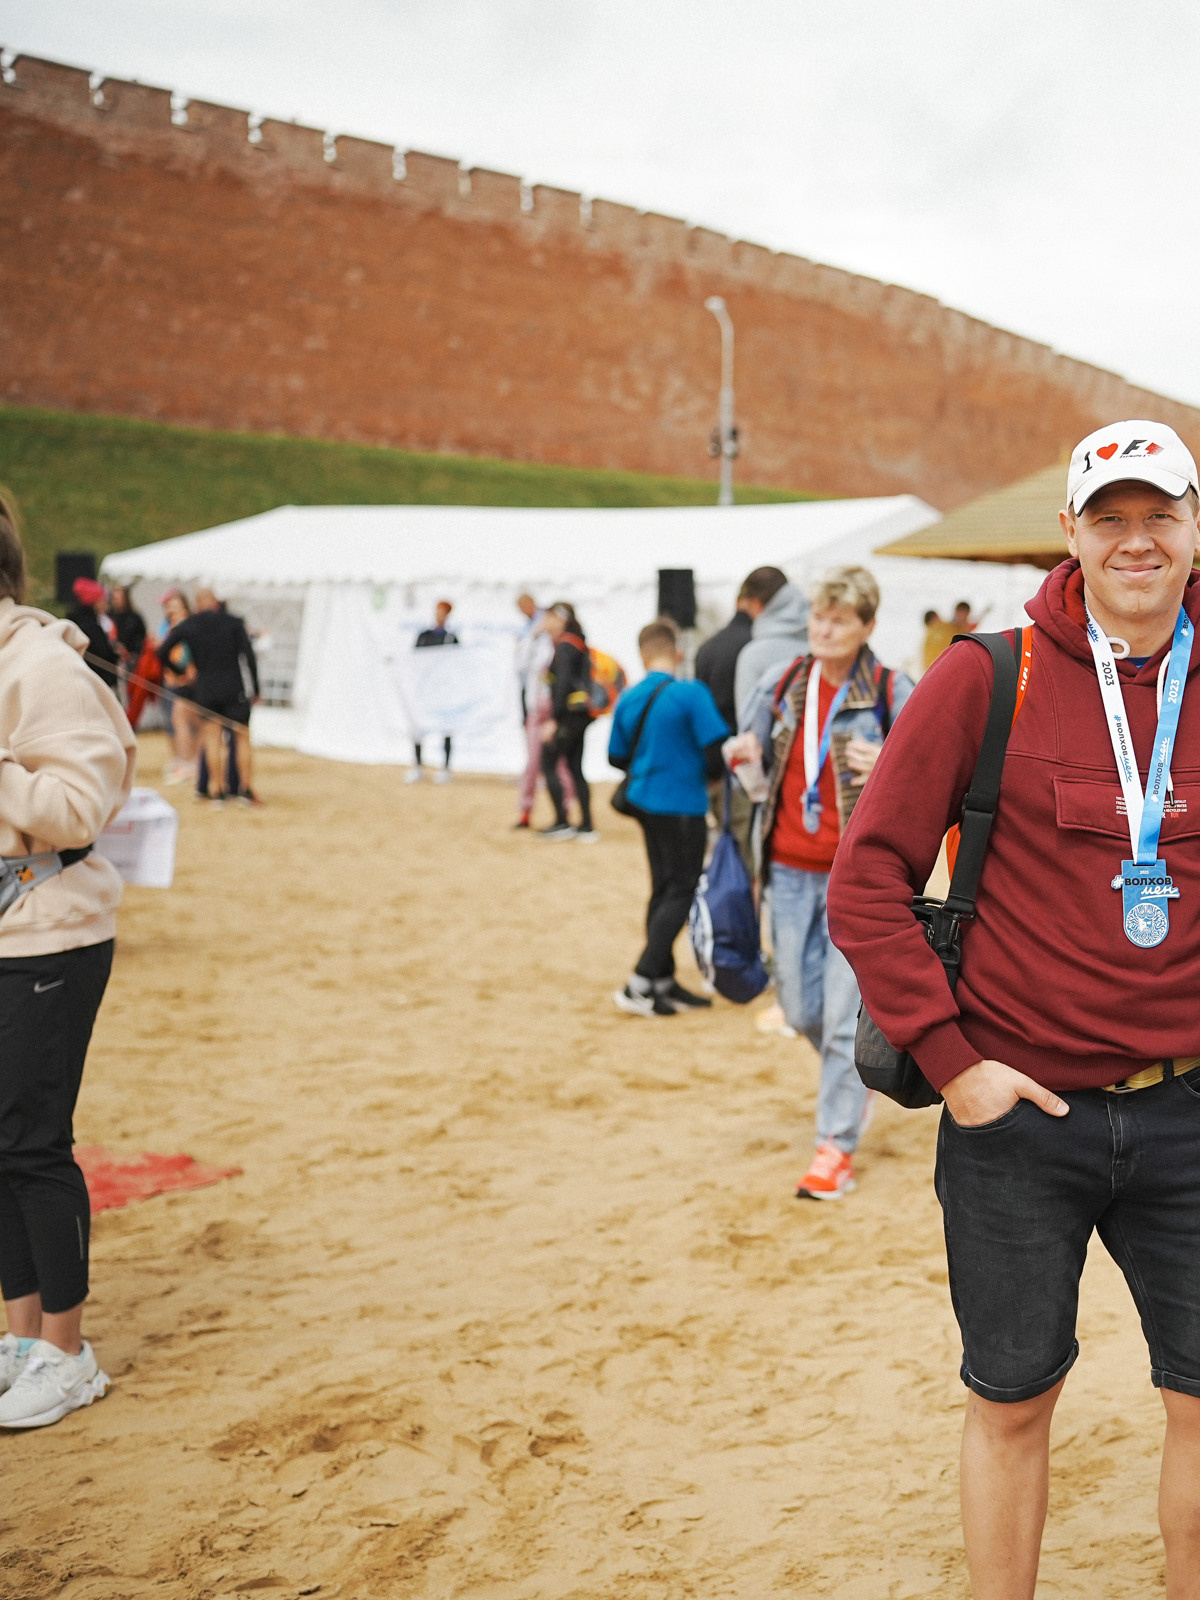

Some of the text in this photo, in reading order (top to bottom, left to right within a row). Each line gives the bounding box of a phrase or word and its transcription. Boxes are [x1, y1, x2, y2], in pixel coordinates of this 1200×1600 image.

[1082, 451, 1093, 474] I
[1101, 661, 1115, 687] 2023
[1167, 678, 1180, 704] 2023
[1113, 876, 1172, 889] #ВОЛХОВ
